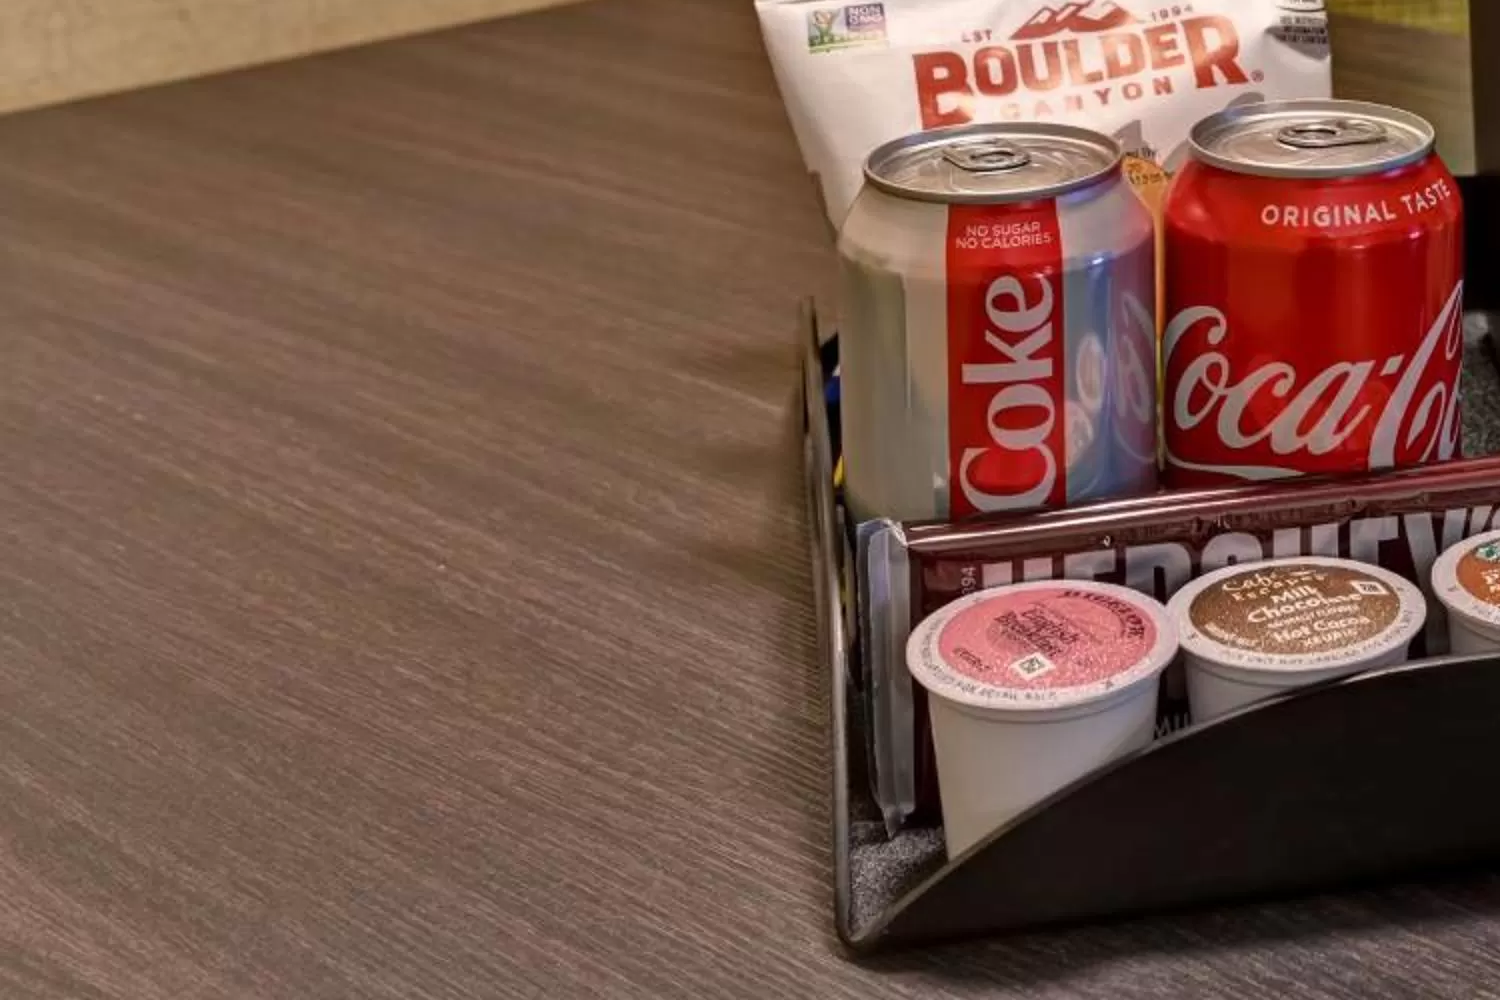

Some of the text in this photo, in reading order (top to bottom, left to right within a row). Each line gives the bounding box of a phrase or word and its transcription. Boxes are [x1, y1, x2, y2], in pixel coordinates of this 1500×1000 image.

[911, 14, 1249, 130] BOULDER
[1001, 76, 1174, 119] CANYON
[1261, 177, 1451, 228] ORIGINAL TASTE
[955, 232, 1052, 249] NO CALORIES
[966, 221, 1041, 237] NO SUGAR
[959, 274, 1057, 514] Coke
